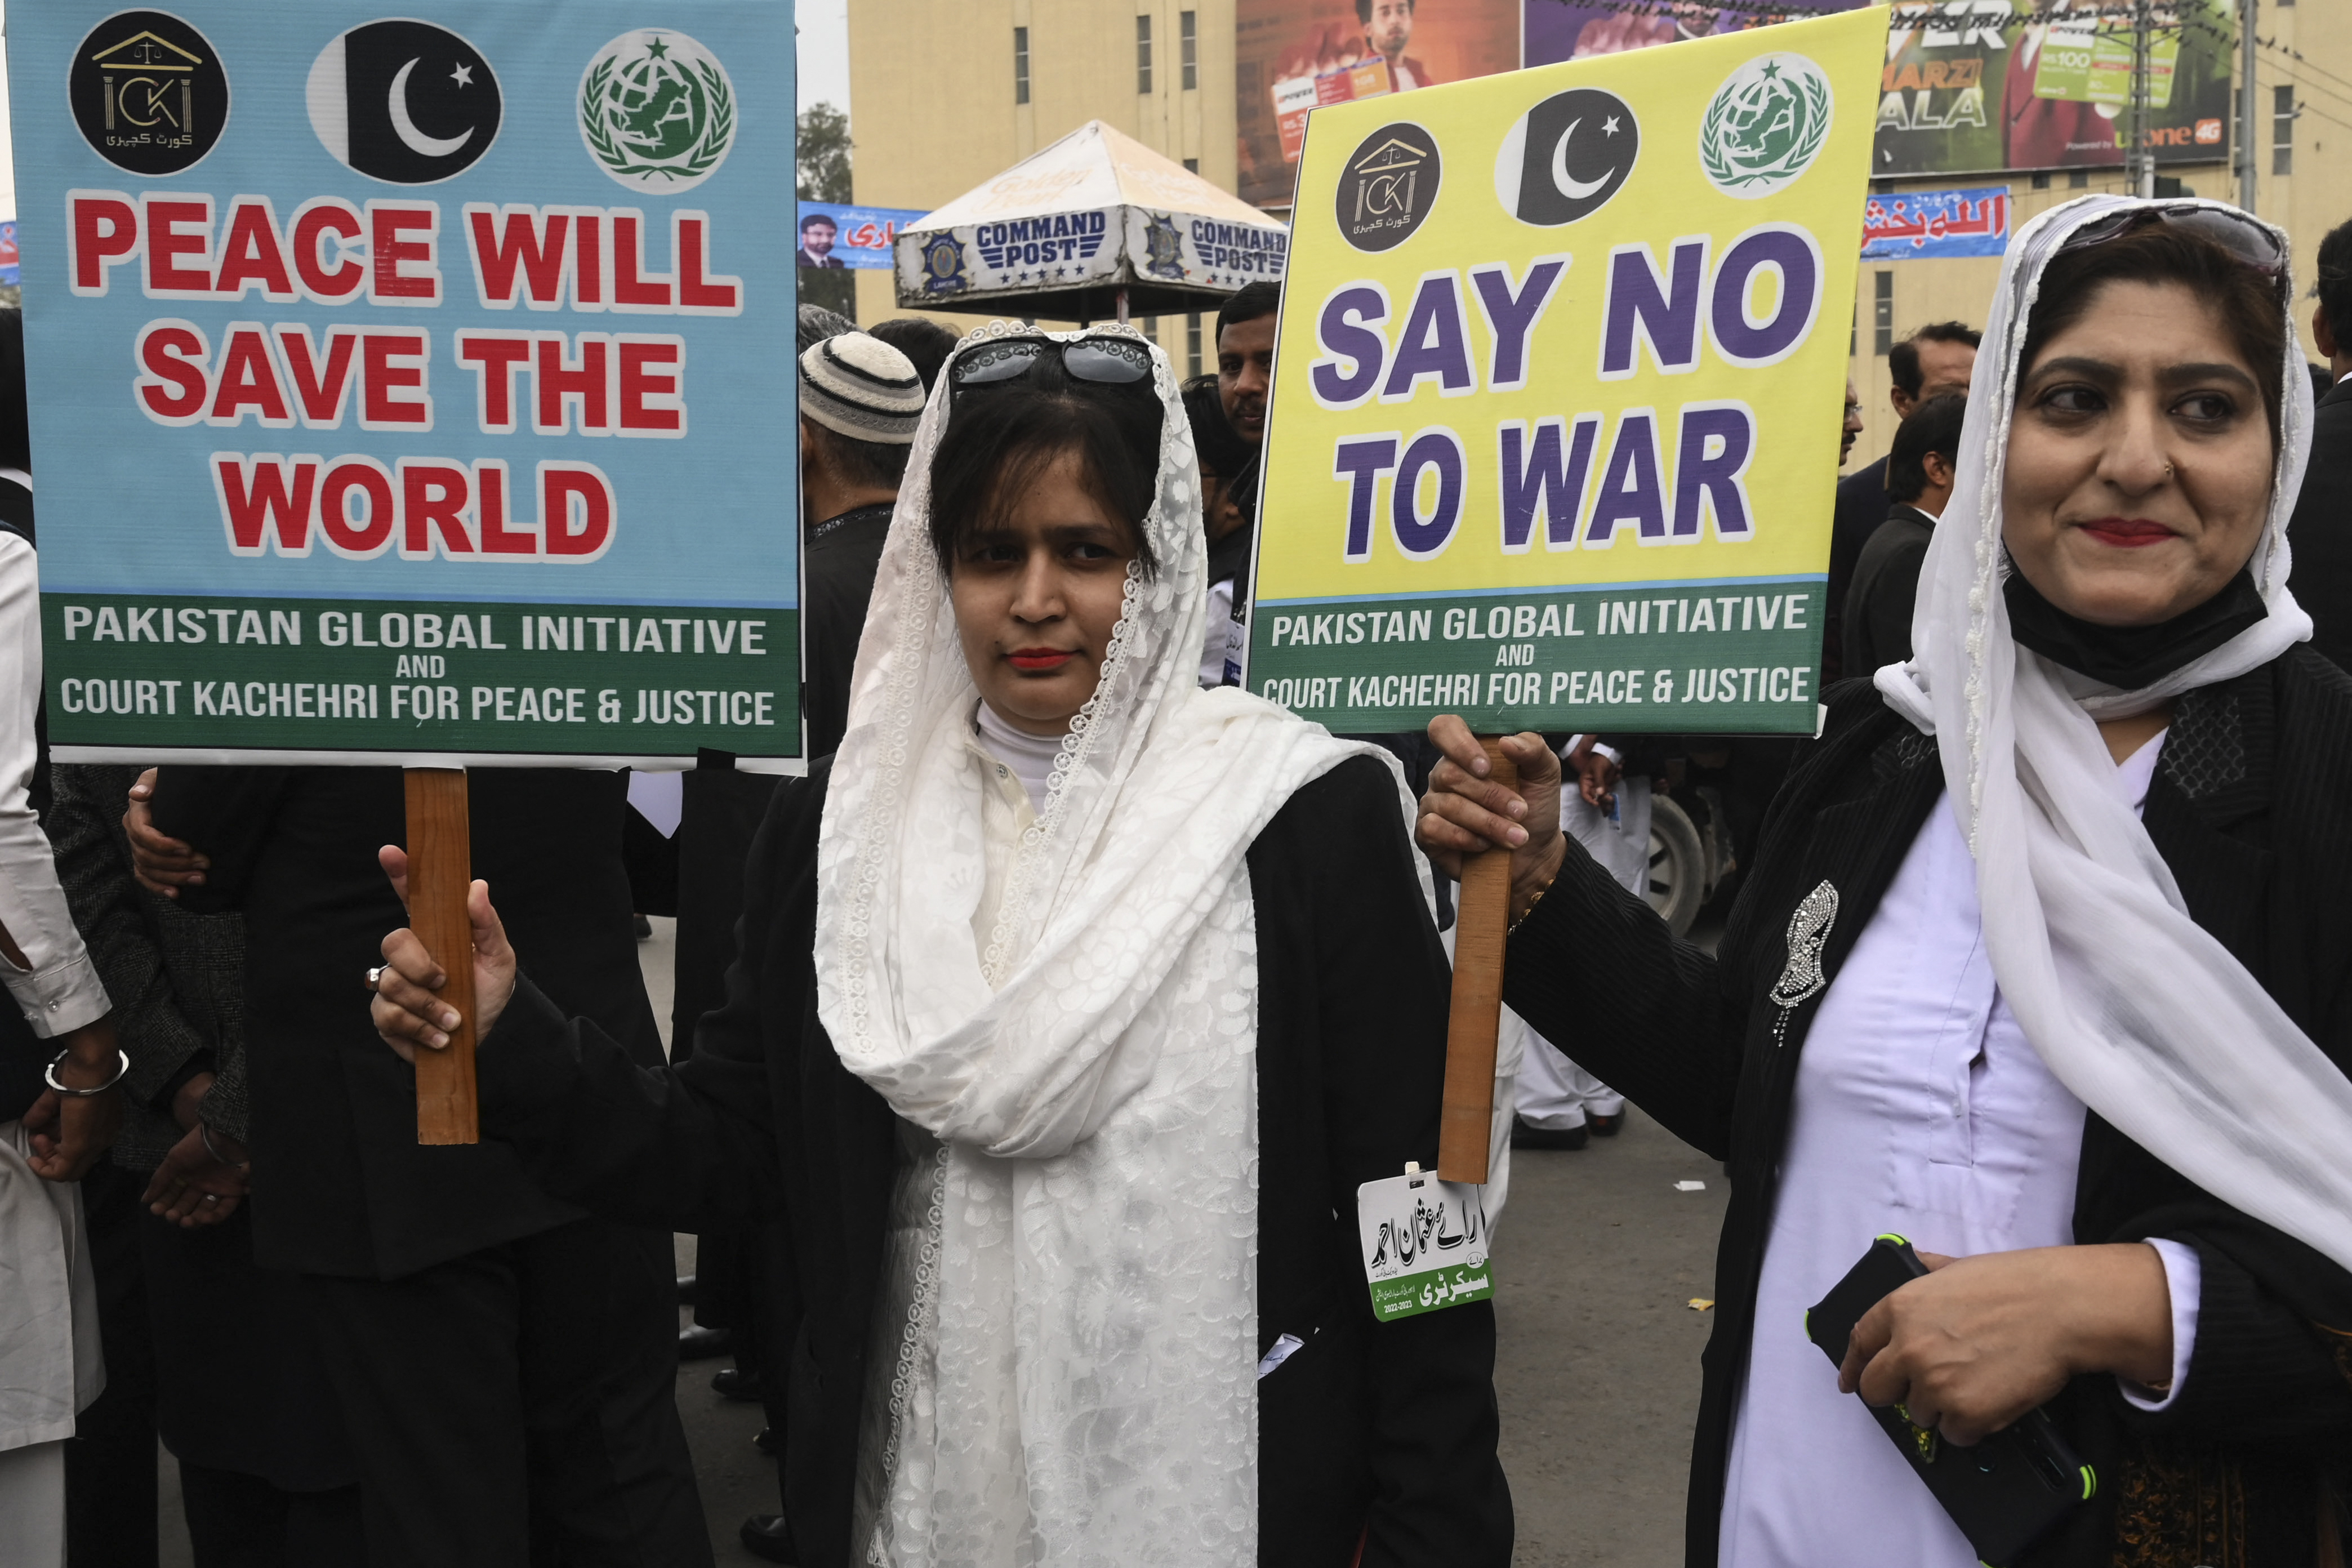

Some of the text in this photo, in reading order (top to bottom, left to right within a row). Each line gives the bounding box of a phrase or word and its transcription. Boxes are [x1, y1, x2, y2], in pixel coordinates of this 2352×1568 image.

[2195, 121, 2221, 140] 4G
[977, 211, 1106, 248] COMMAND
[1191, 220, 1286, 253] COMMAND
[75, 200, 435, 297] PEACE
[472, 213, 736, 306] WILL
[1006, 238, 1077, 268] POST
[1215, 247, 1267, 273] POST
[1314, 231, 1815, 402] SAY NO
[144, 328, 679, 429] SAVE THE
[1336, 409, 1749, 555] TO WAR
[220, 462, 609, 554] WORLD
[65, 607, 766, 654] PAKISTAN GLOBAL INITIATIVE
[1272, 610, 1432, 646] PAKISTAN
[1444, 604, 1584, 640] GLOBAL
[1597, 594, 1808, 635] INITIATIVE
[397, 655, 444, 678] AND
[1496, 644, 1534, 666] AND
[62, 679, 774, 725] COURT KACHEHRI FOR PEACE & JUSTICE
[1263, 667, 1810, 709] COURT KACHEHRI FOR PEACE & JUSTICE
[1371, 1217, 1398, 1267] احمد
[1398, 1197, 1436, 1267] عثمان
[1384, 1299, 1413, 1313] 2022-2023
[1419, 1270, 1489, 1307] سیکرٹری
